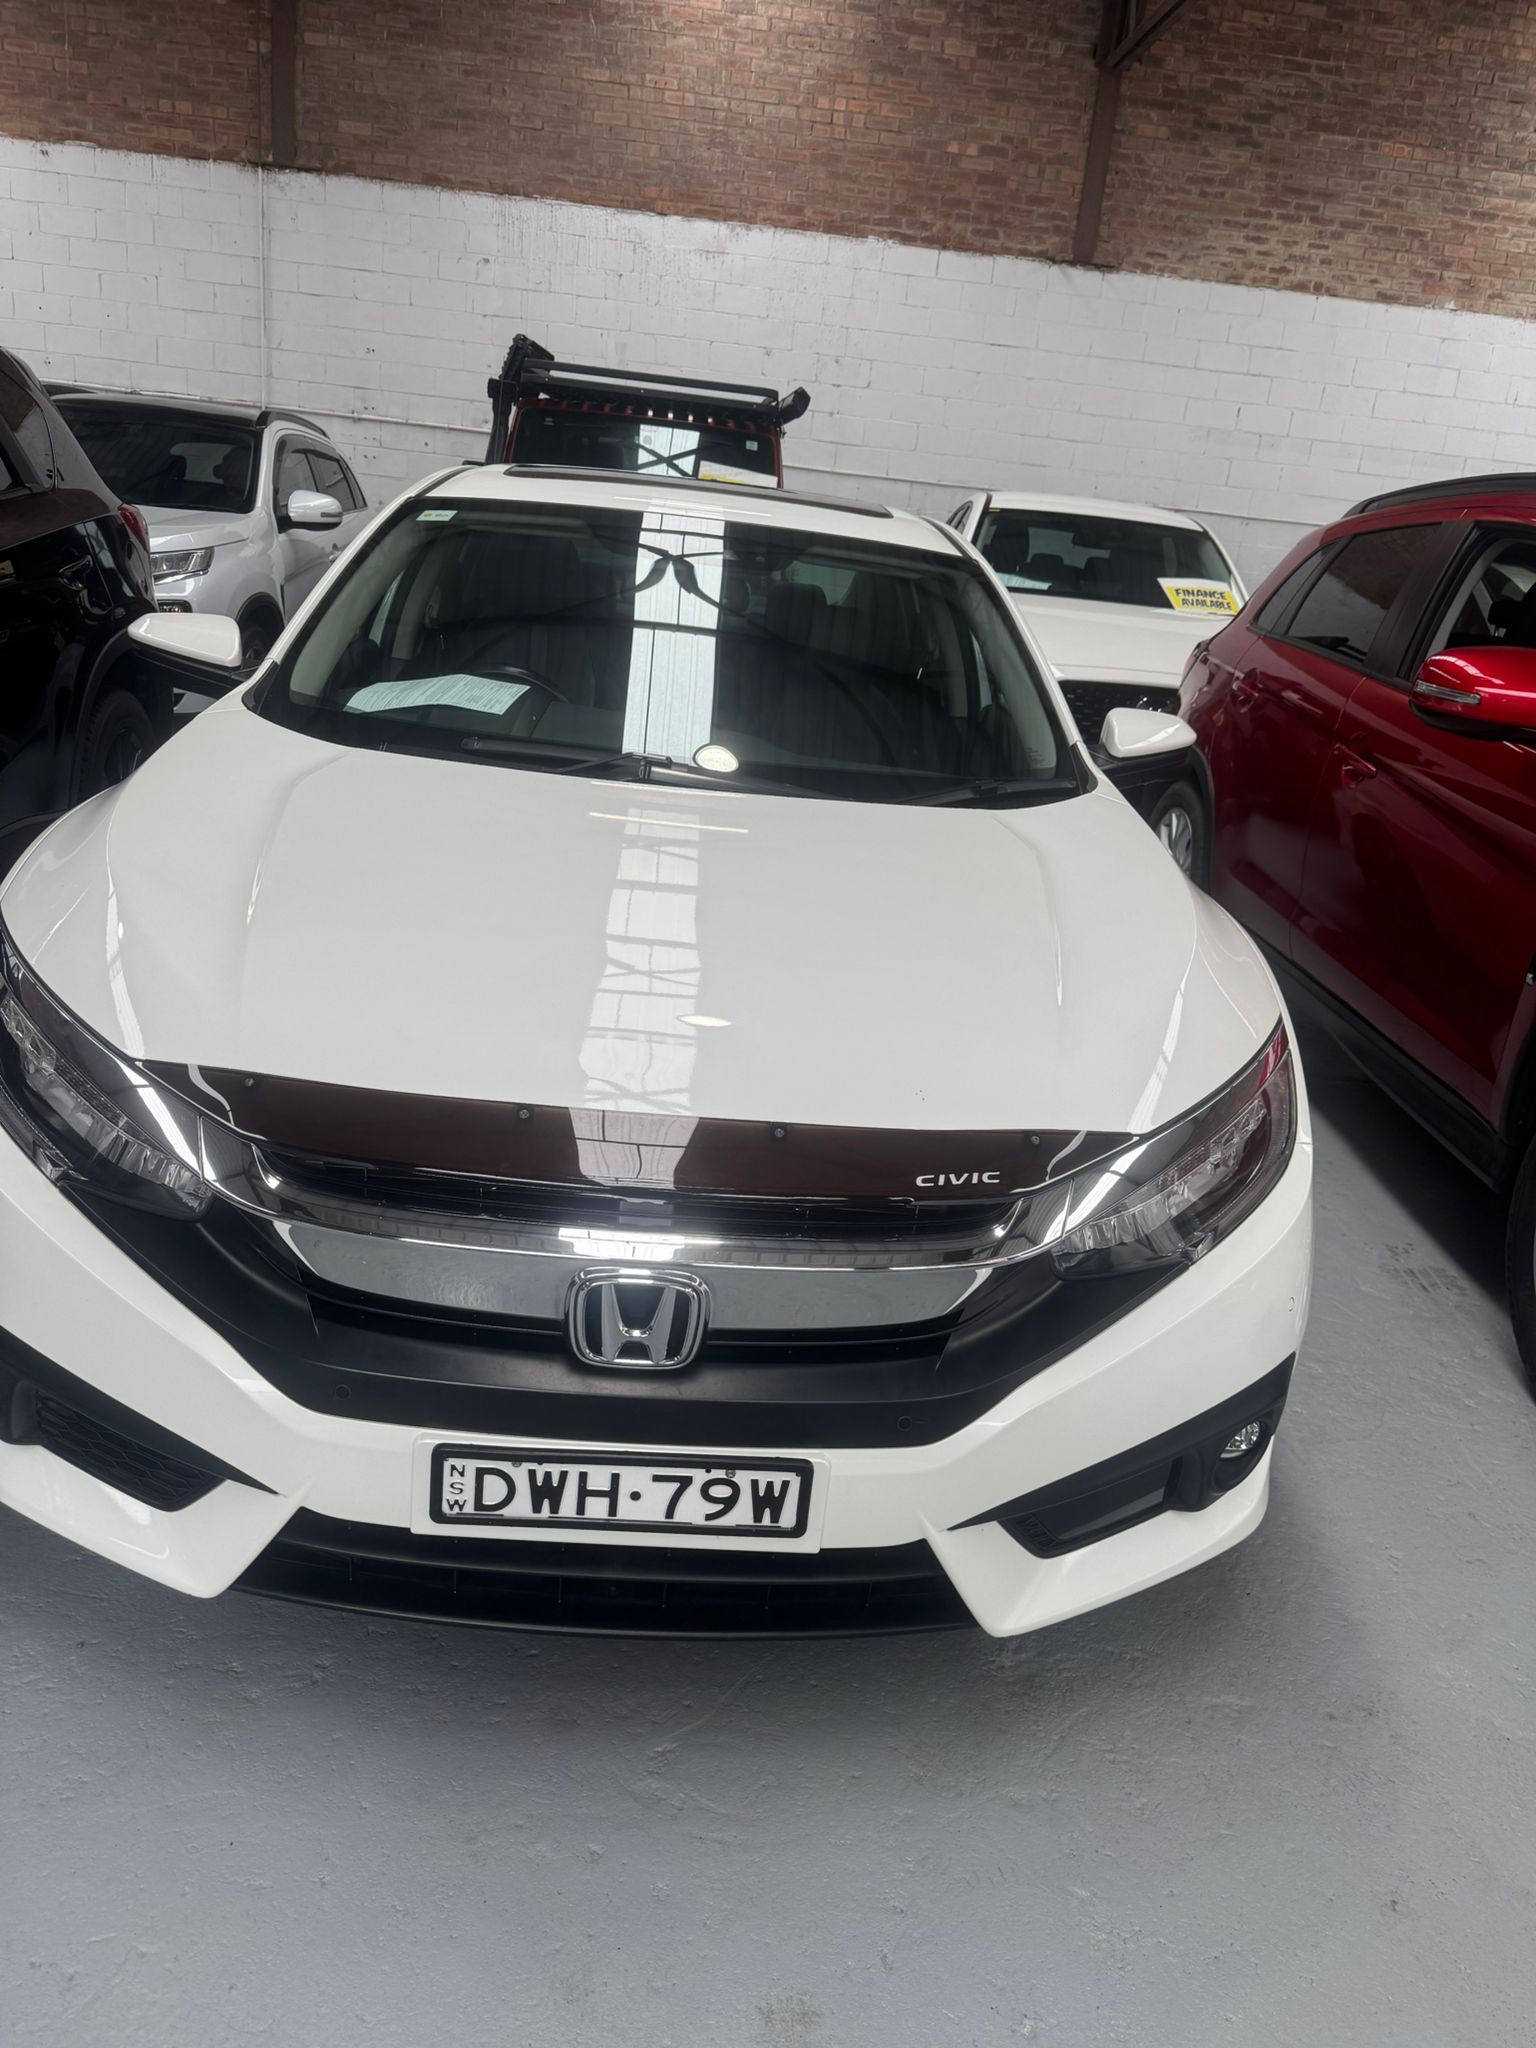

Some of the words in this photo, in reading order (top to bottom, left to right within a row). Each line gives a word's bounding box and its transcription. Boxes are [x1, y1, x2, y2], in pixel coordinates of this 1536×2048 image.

[1174, 588, 1227, 600] FINANCE
[1181, 598, 1232, 610] AVAILABLE
[915, 1171, 1001, 1187] CIVIC
[446, 1464, 467, 1512] NSW
